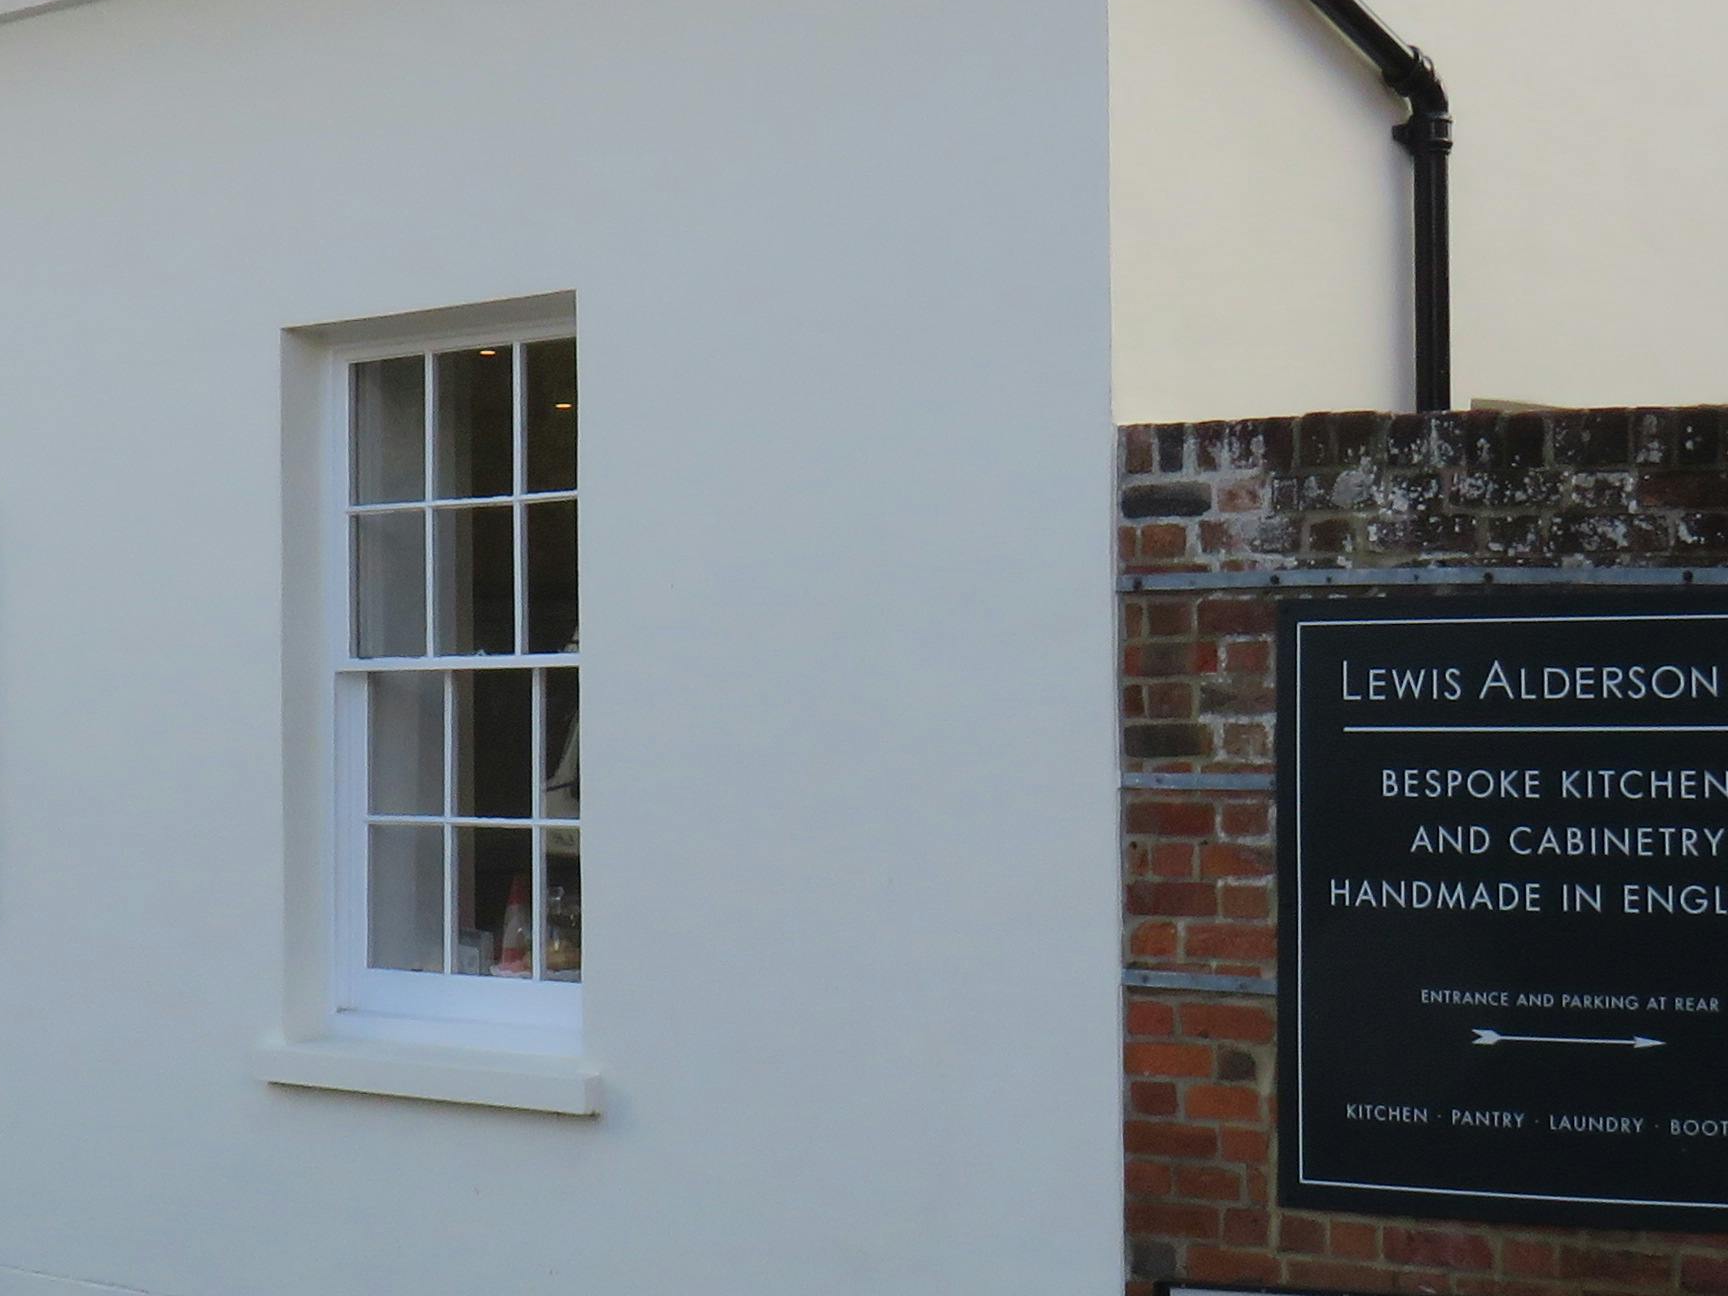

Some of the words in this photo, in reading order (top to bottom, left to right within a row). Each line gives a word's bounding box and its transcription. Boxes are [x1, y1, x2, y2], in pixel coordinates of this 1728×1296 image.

[1381, 769, 1541, 800] BESPOKE
[1410, 825, 1490, 855] AND
[1509, 826, 1726, 857] CABINETRY
[1329, 878, 1542, 912] HANDMADE
[1562, 884, 1602, 913] IN
[1420, 989, 1510, 1008] ENTRANCE
[1515, 992, 1556, 1009] AND
[1561, 993, 1640, 1012] PARKING
[1645, 996, 1668, 1012] AT
[1674, 996, 1720, 1013] REAR
[1345, 1103, 1429, 1124] KITCHEN
[1450, 1109, 1525, 1129] PANTRY
[1548, 1113, 1645, 1134] LAUNDRY
